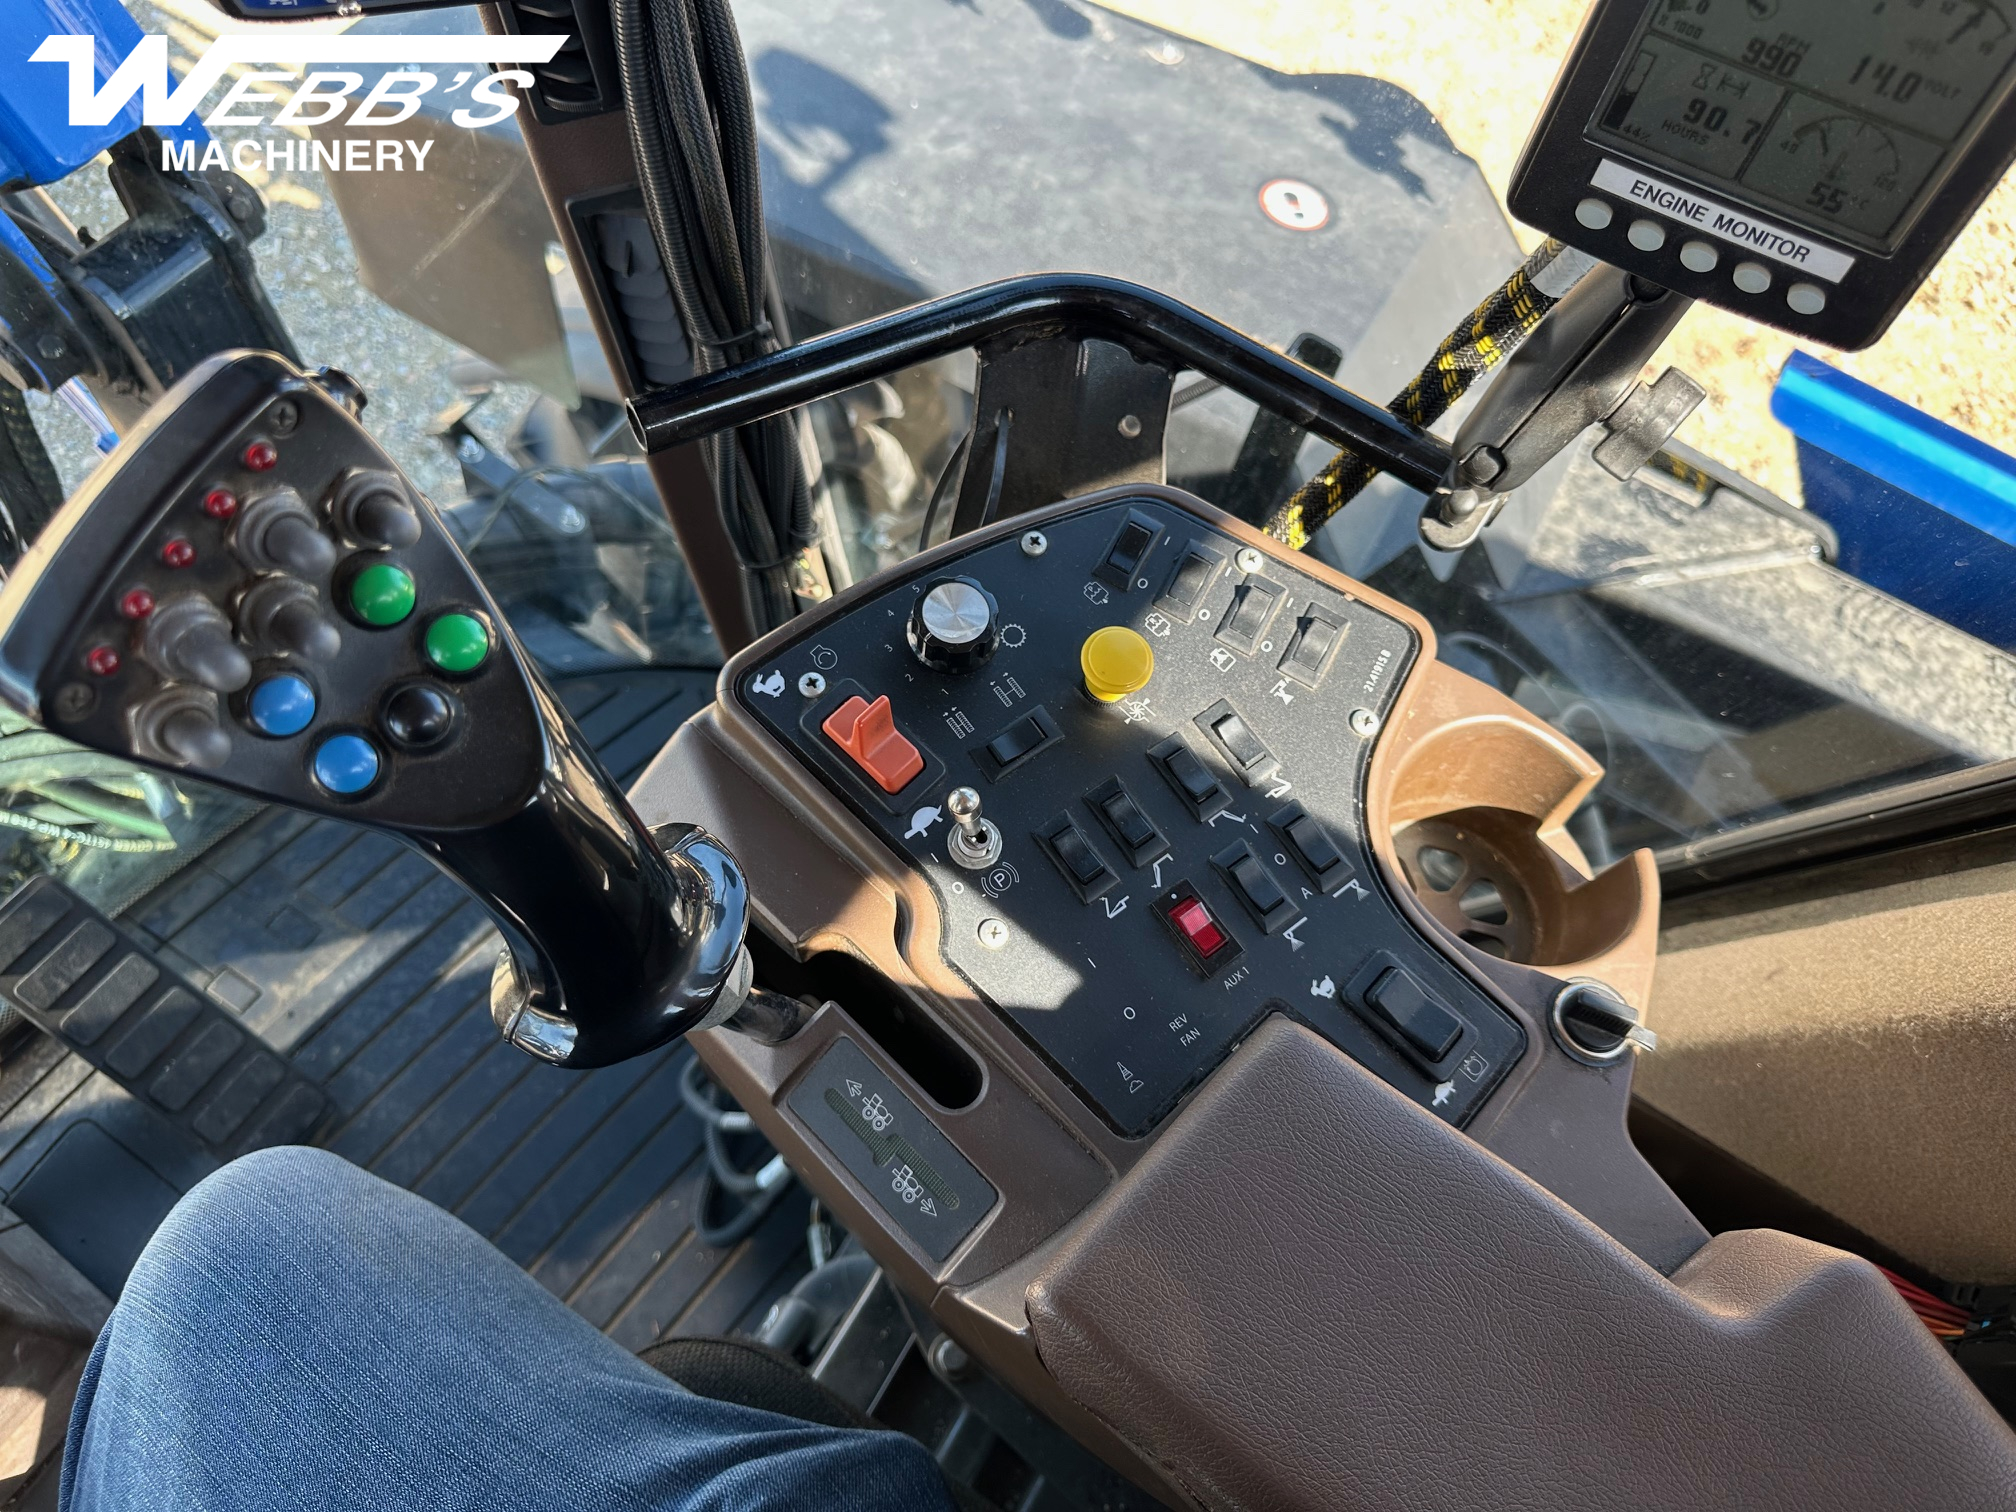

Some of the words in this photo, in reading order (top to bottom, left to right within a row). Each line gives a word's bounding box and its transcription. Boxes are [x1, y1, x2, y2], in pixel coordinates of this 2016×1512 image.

[1741, 37, 1803, 78] 990
[1849, 55, 1923, 103] 14.0
[1661, 119, 1710, 145] HOURS
[1682, 98, 1761, 144] 90.7
[1805, 181, 1848, 214] 55
[1629, 179, 1710, 223] ENGINE
[1711, 213, 1812, 263] MONITOR
[911, 584, 921, 594] 5
[887, 609, 895, 618] 4
[884, 644, 893, 653] 3
[904, 673, 914, 683] 2
[1301, 887, 1313, 899] A
[1223, 970, 1245, 990] AUX
[1241, 966, 1250, 975] 1
[1168, 1012, 1189, 1033] REV
[1179, 1027, 1202, 1047] FAN
